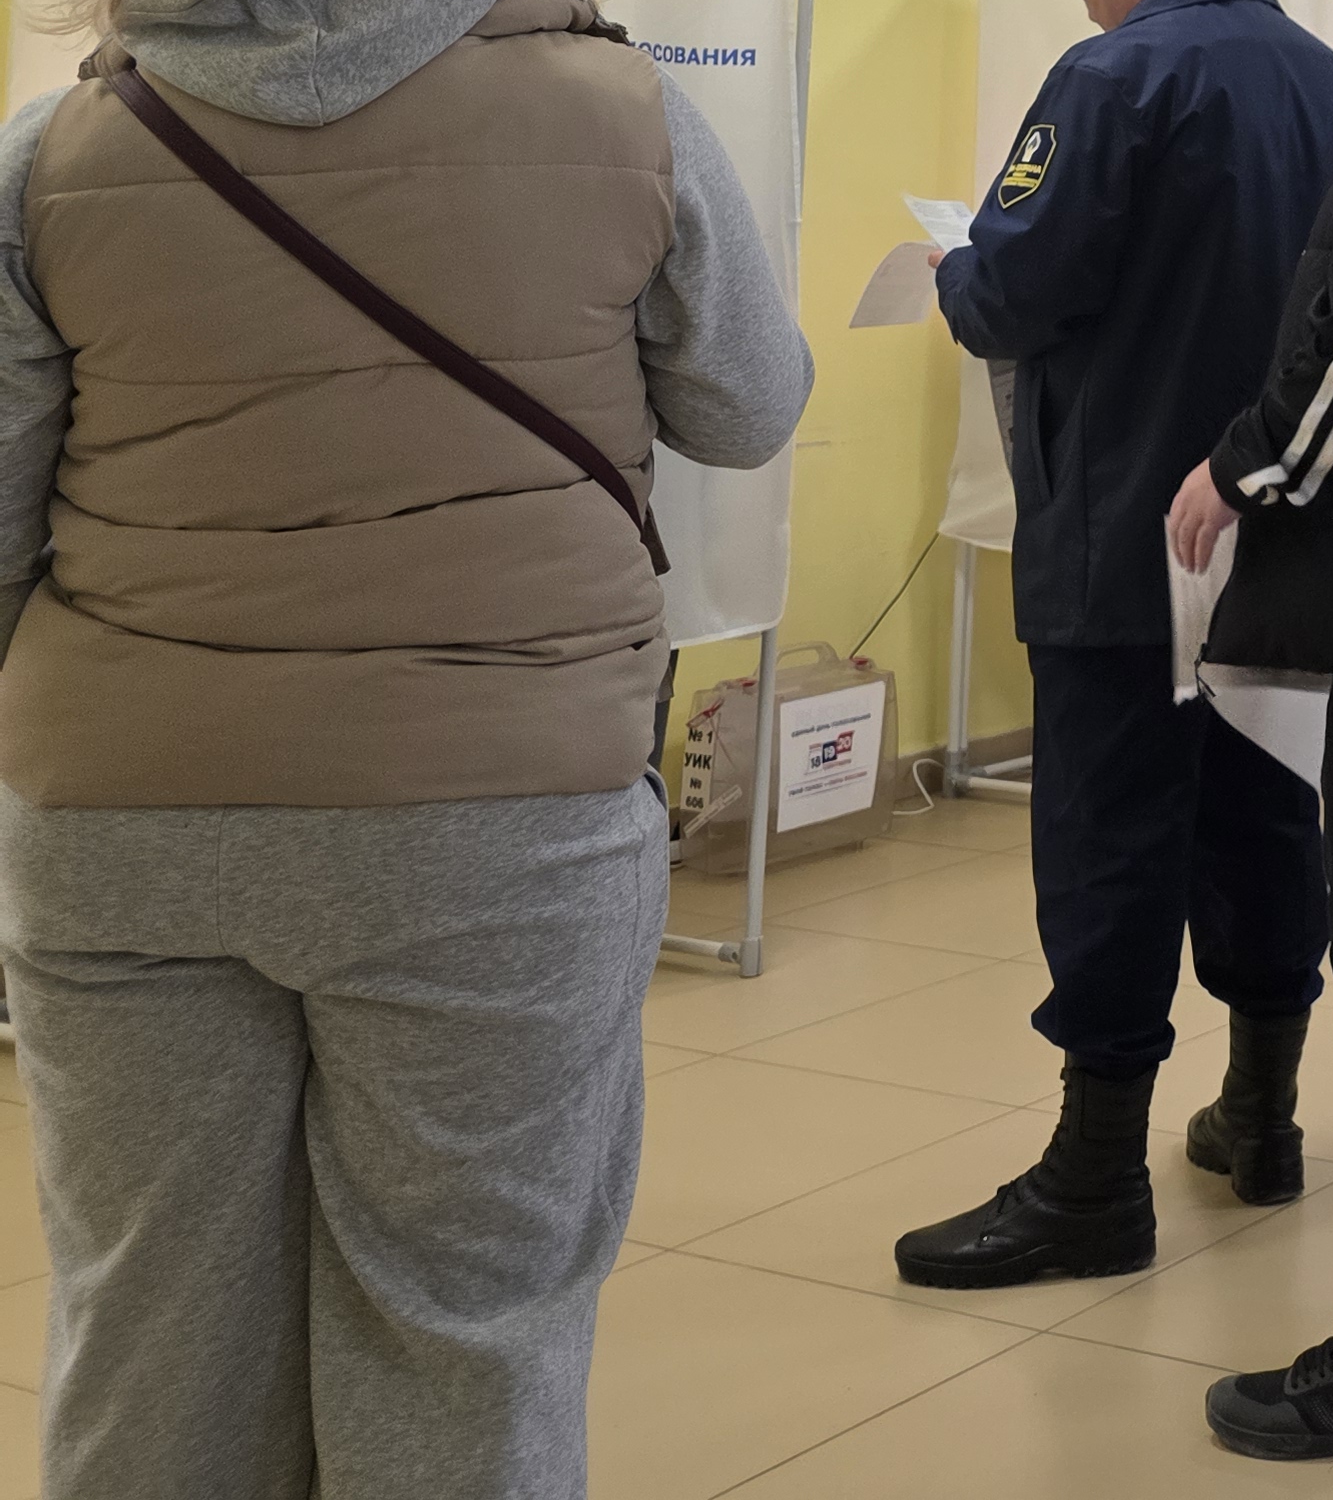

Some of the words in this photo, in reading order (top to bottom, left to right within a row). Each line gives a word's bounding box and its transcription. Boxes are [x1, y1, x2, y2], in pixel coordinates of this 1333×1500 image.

[706, 730, 713, 744] 1
[837, 735, 852, 751] 20
[684, 752, 712, 770] УИК
